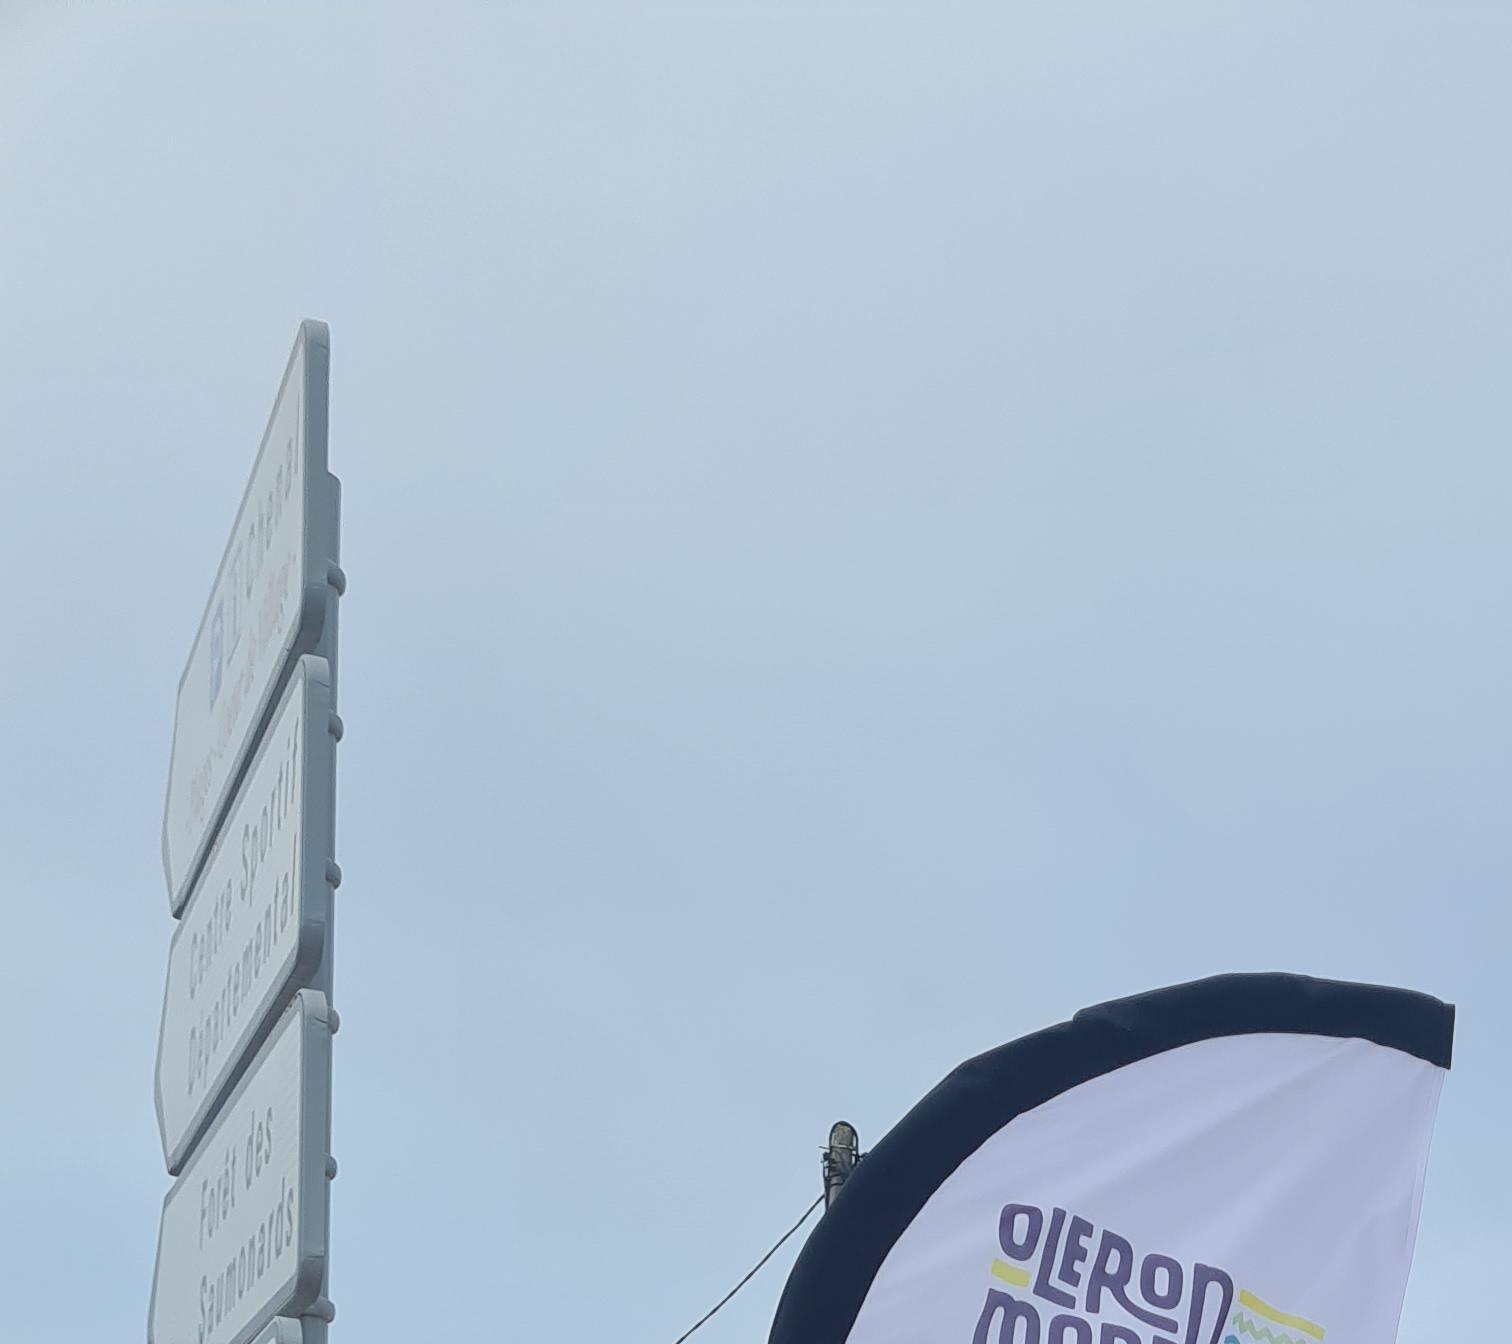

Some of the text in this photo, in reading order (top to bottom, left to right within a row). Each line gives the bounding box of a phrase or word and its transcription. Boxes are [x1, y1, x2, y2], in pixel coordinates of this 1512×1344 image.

[187, 833, 298, 1095] Départemental
[189, 715, 299, 997] Centre Sportif
[200, 1103, 273, 1250] Forêt des
